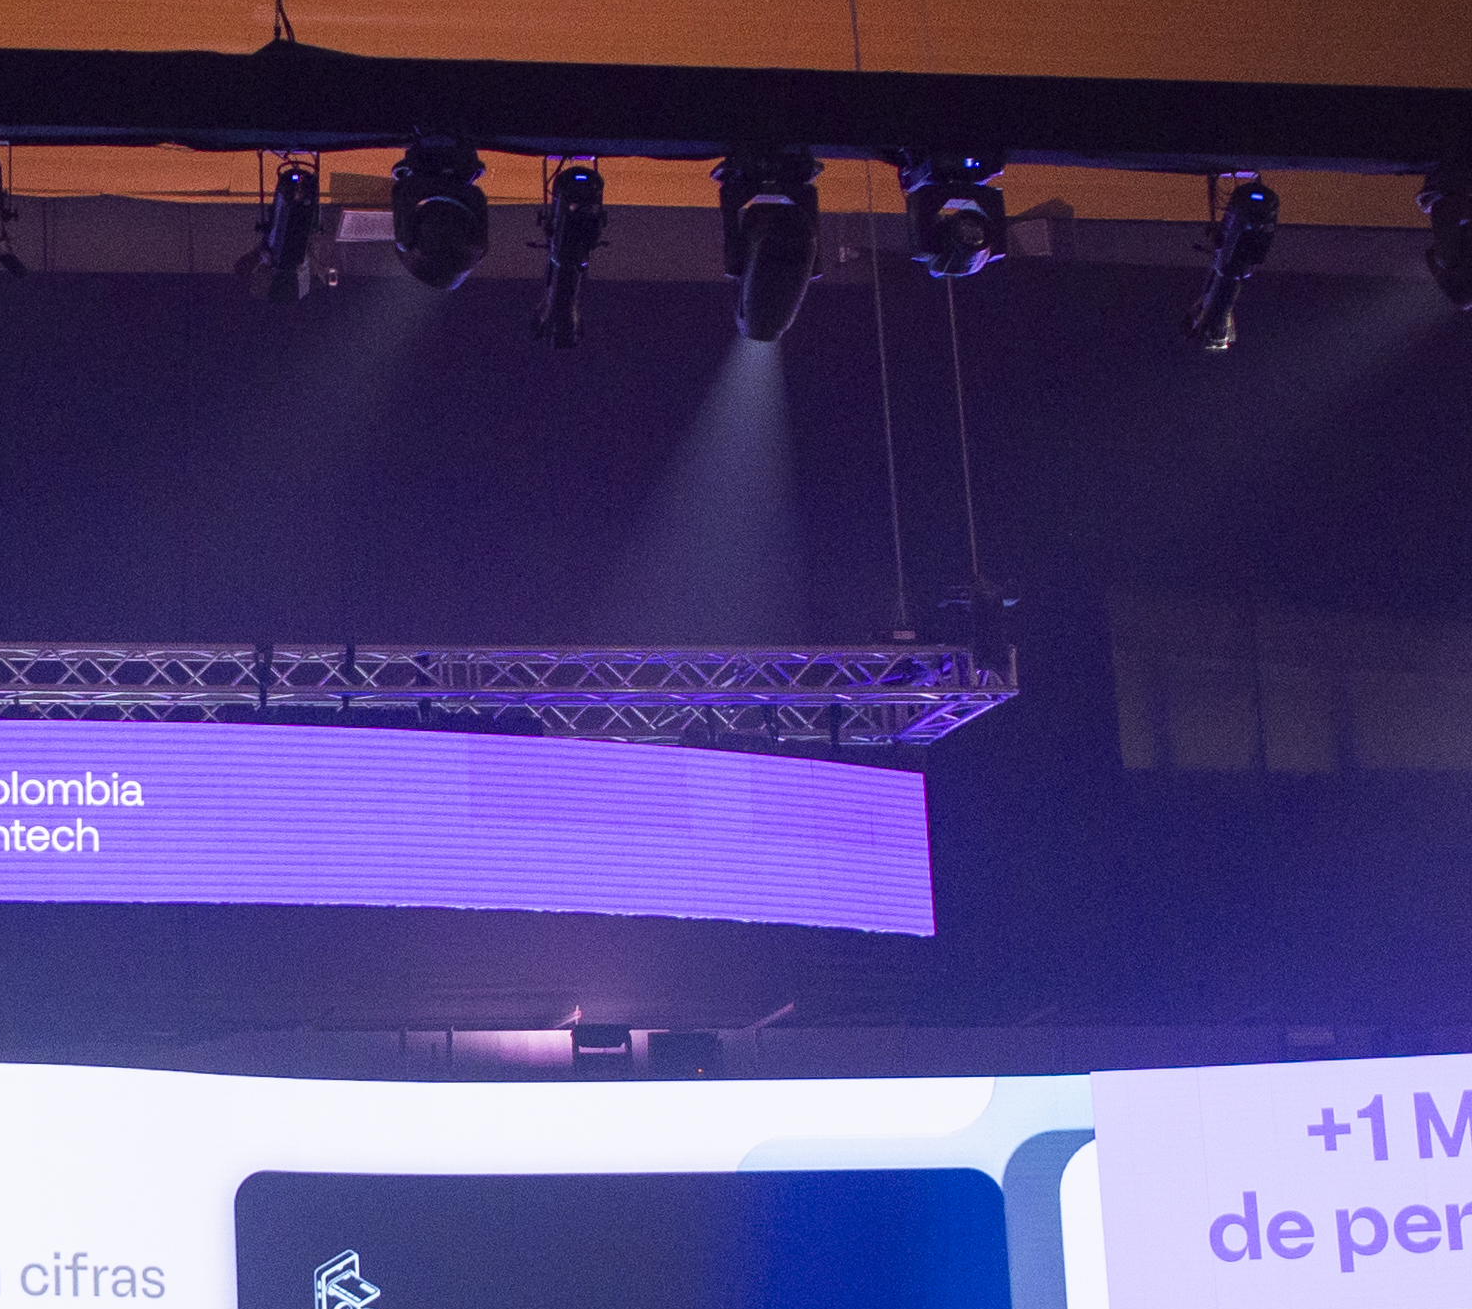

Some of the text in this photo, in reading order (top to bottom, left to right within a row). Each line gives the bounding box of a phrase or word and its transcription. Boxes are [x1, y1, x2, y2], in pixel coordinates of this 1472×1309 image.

[1307, 1094, 1389, 1161] +1
[1209, 1191, 1315, 1263] de
[20, 1252, 165, 1299] cifras
